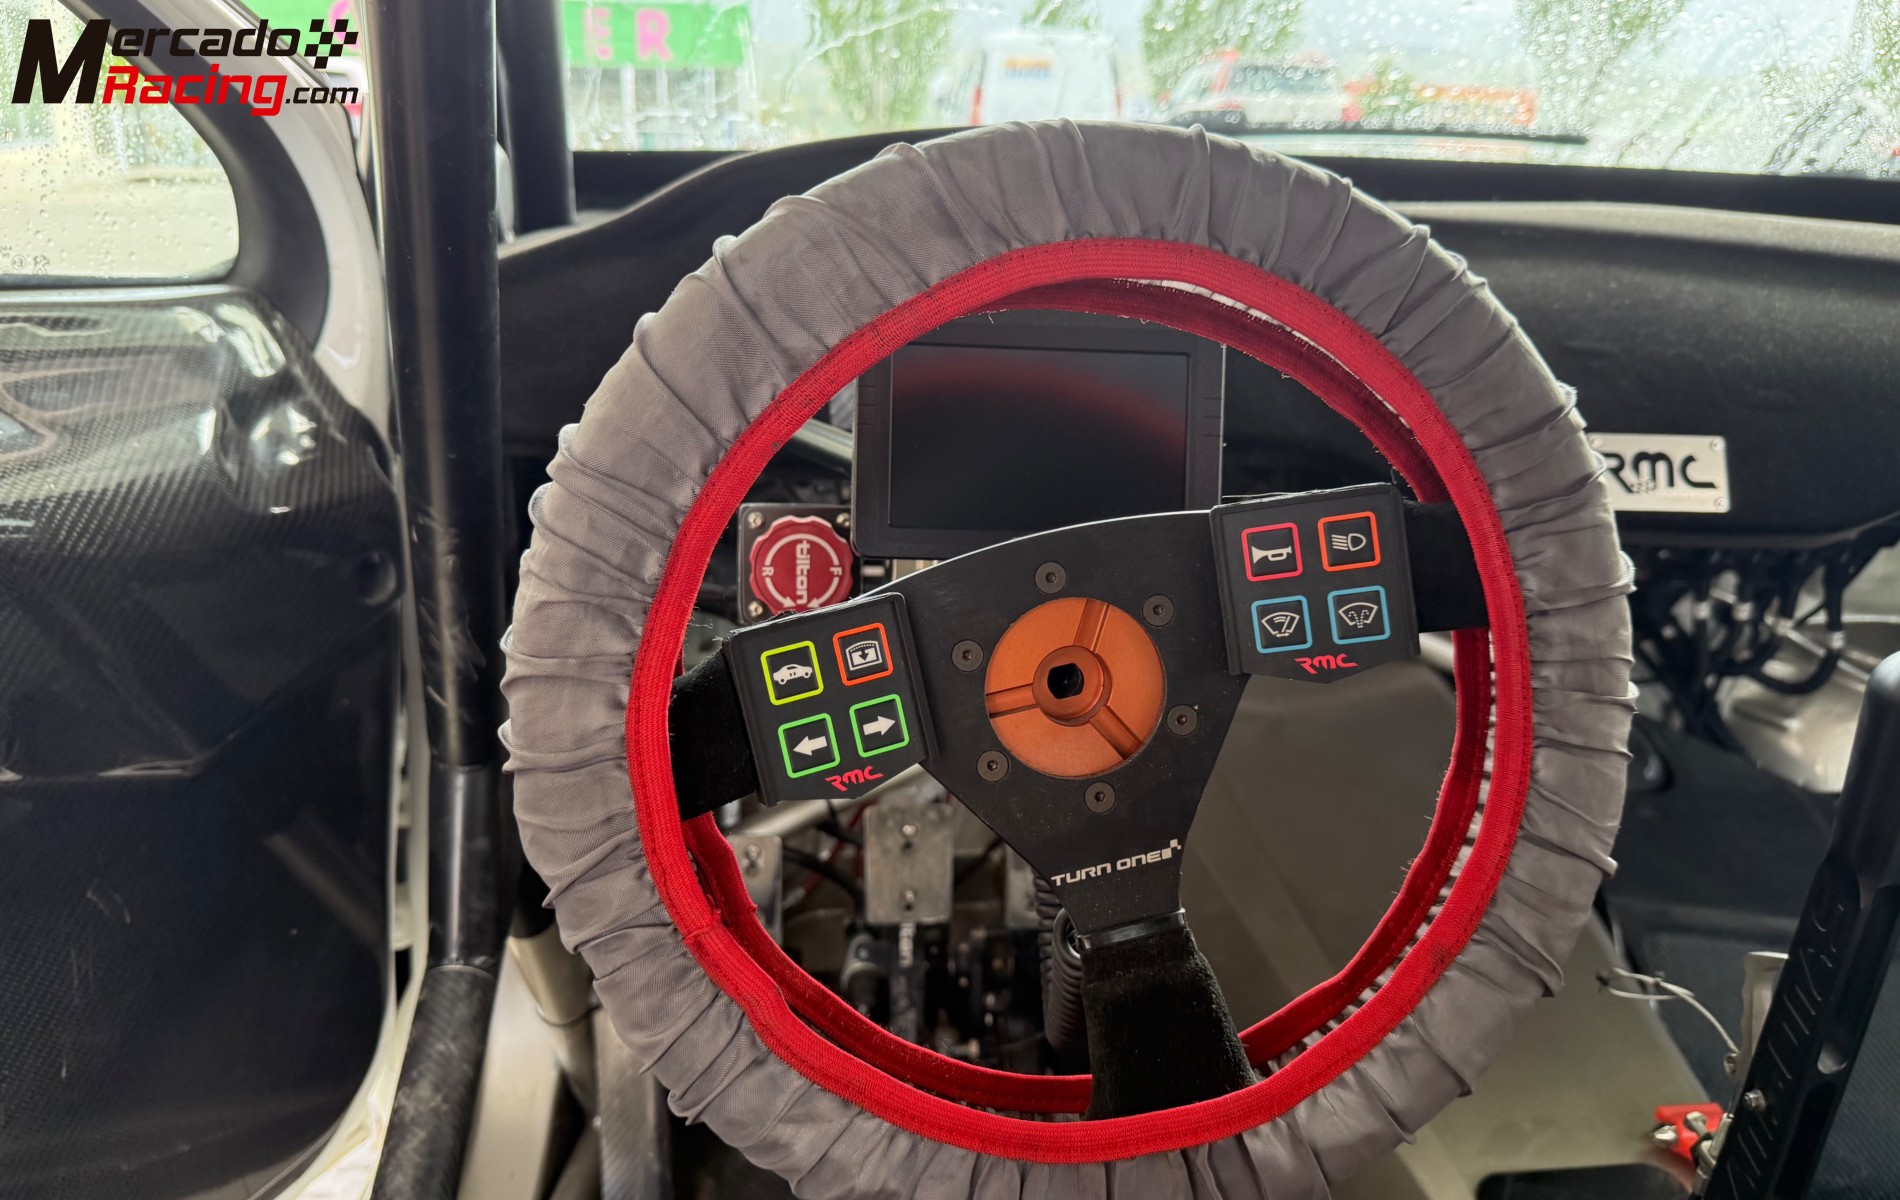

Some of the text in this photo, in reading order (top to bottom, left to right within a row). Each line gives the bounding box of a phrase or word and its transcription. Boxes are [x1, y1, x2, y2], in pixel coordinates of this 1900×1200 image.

[796, 540, 811, 605] tilton
[1294, 653, 1358, 674] RMC
[825, 765, 884, 792] RMC
[1051, 850, 1162, 887] TURN ONE
